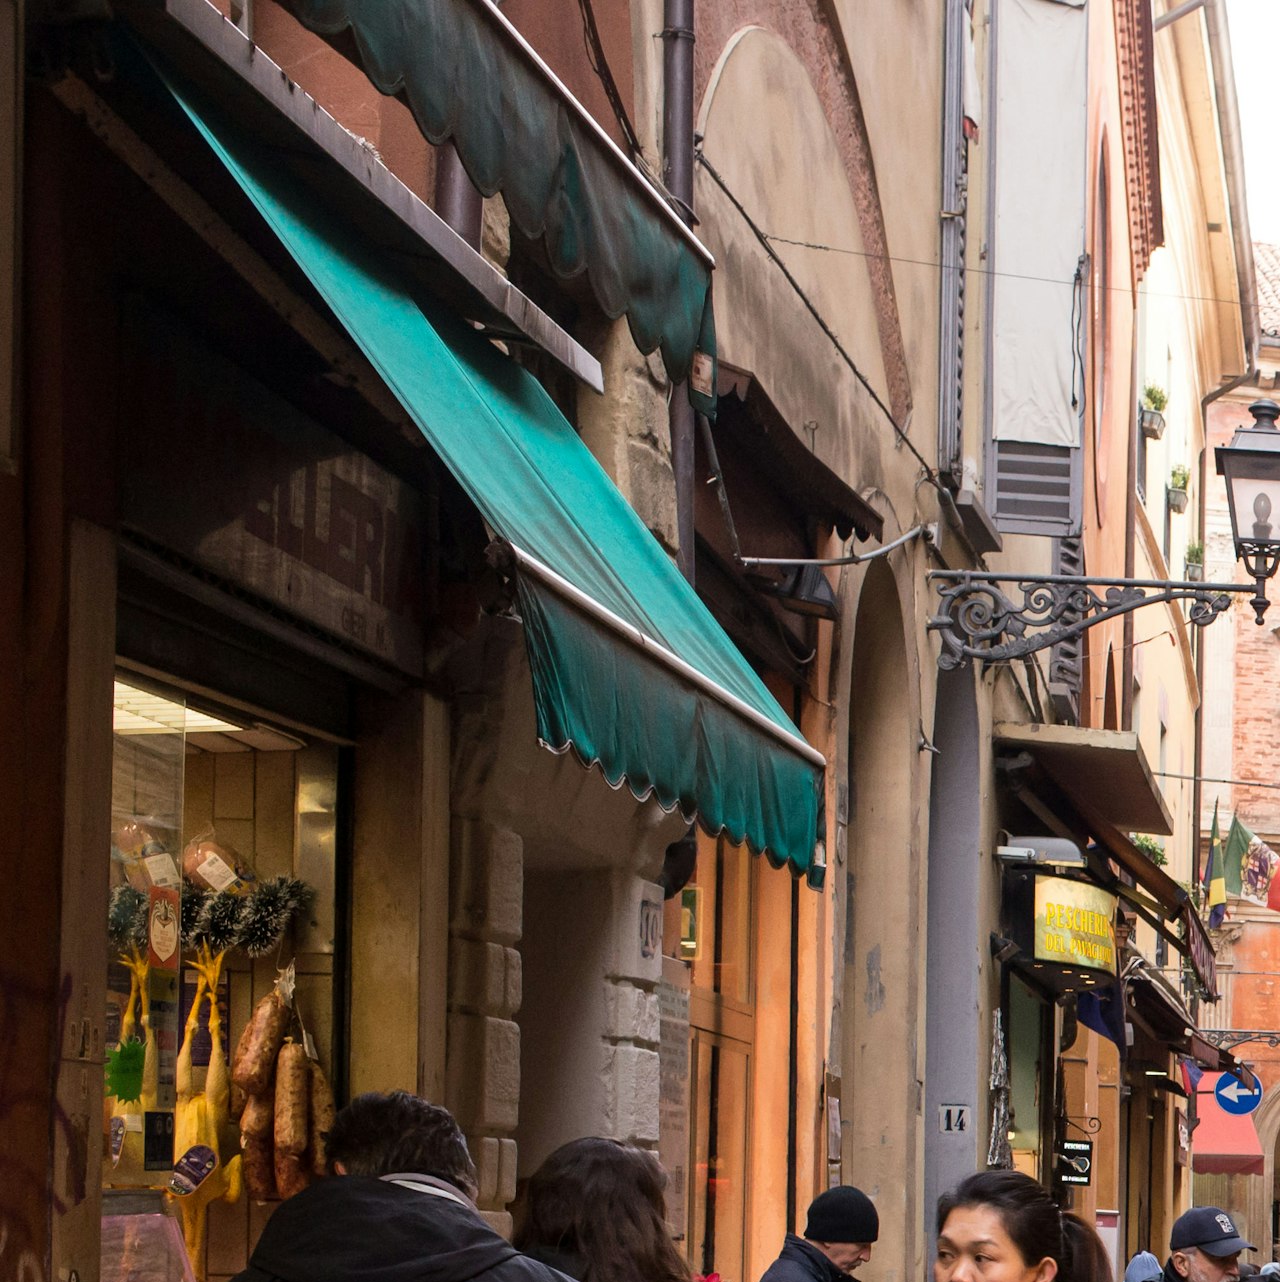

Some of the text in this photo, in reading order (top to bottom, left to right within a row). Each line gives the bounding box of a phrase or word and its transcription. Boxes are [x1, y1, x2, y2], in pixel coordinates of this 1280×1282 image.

[1045, 902, 1109, 938] PESCHERIA
[1045, 932, 1066, 953] DEL
[944, 1108, 966, 1131] 14
